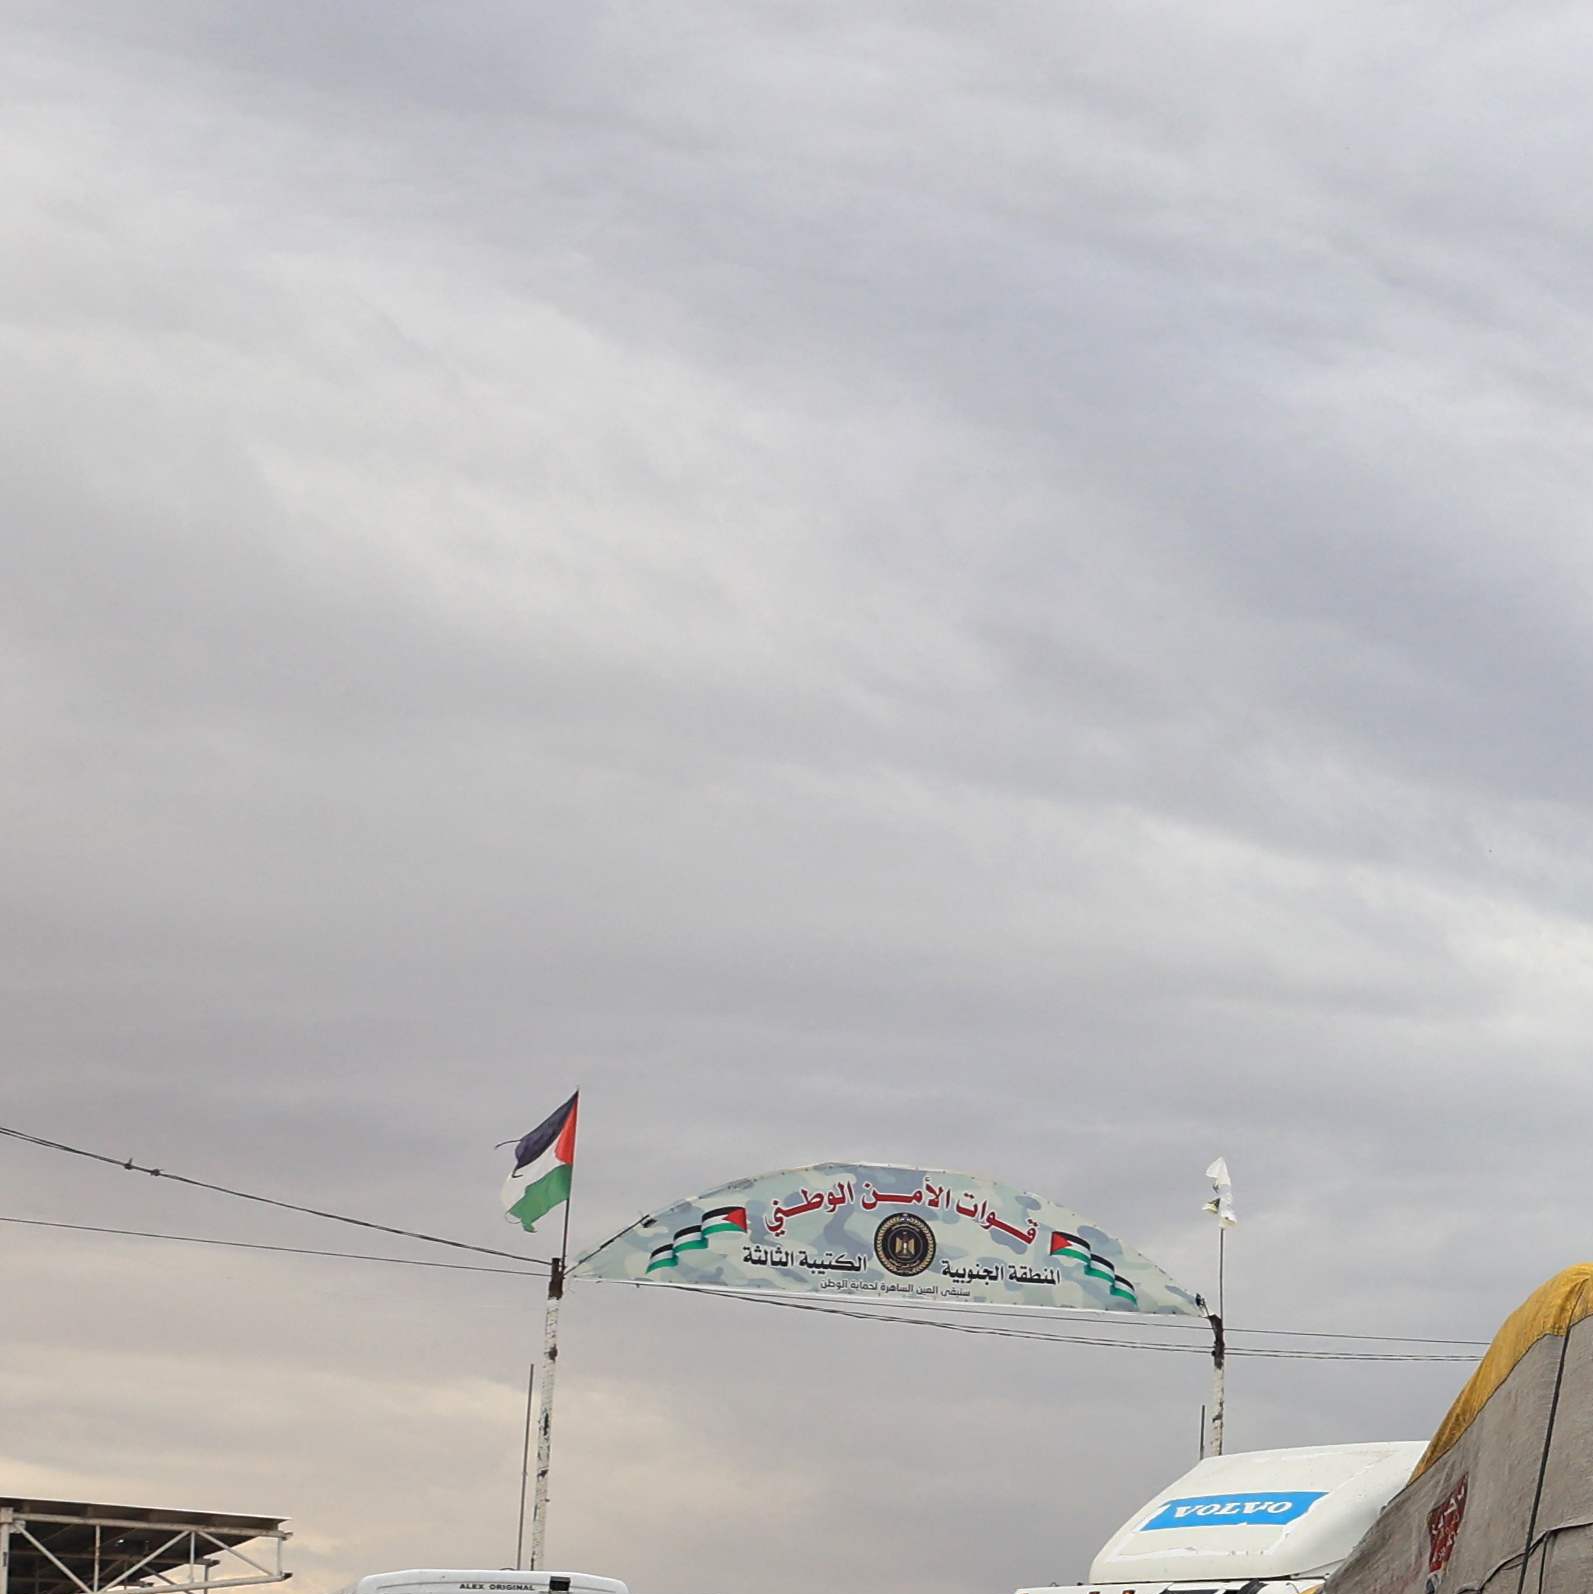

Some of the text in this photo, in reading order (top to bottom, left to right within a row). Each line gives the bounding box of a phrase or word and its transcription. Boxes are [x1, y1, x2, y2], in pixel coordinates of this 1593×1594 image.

[765, 1176, 1039, 1245] قوات الأمن الوطني
[743, 1245, 867, 1275] الكتيبة الثالثة
[940, 1259, 1061, 1285] المنطقة الجنوبية
[820, 1278, 848, 1289] الوطن
[850, 1280, 878, 1291] لحماية
[880, 1282, 913, 1293] الساهرة
[915, 1285, 938, 1296] العين
[1173, 1500, 1293, 1520] VOLVO
[459, 1583, 536, 1592] ALEX ORIGINAL
